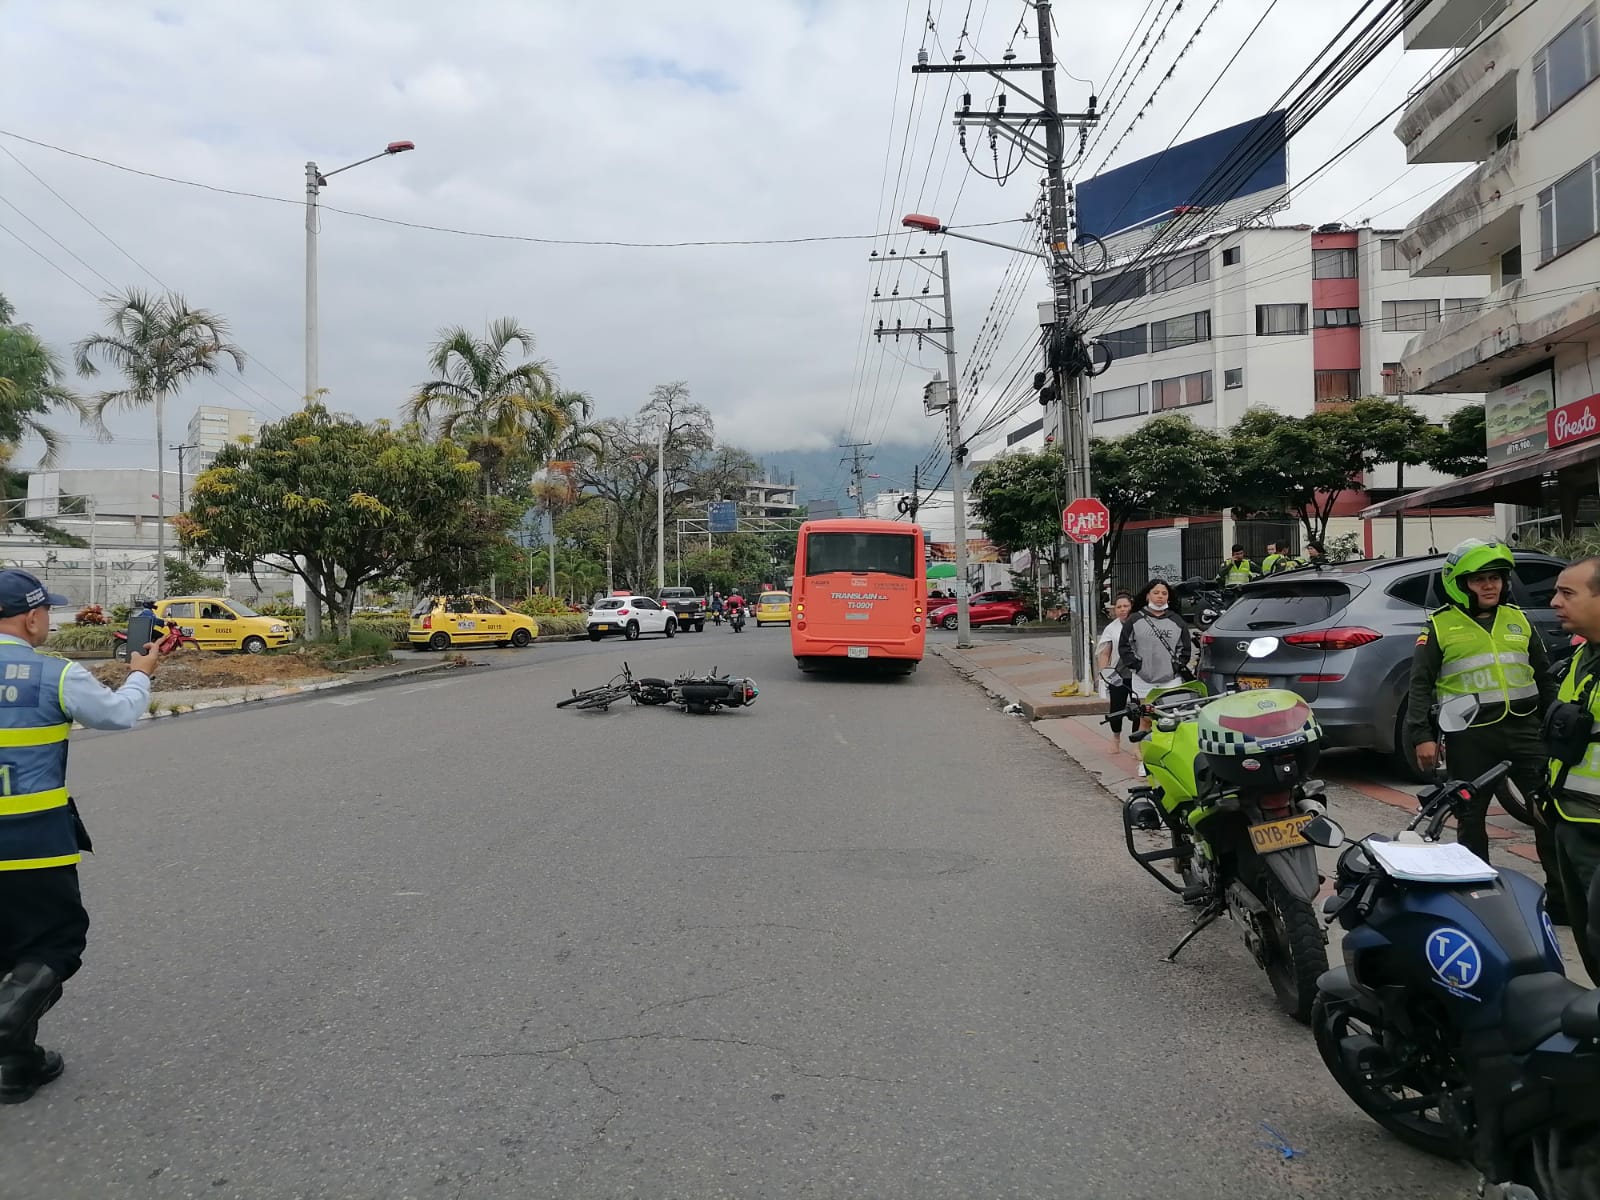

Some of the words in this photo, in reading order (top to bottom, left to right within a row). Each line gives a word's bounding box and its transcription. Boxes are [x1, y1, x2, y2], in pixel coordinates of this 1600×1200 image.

[1554, 405, 1597, 441] Presto
[1067, 511, 1105, 529] PARE
[831, 592, 877, 600] TRANSLAIN
